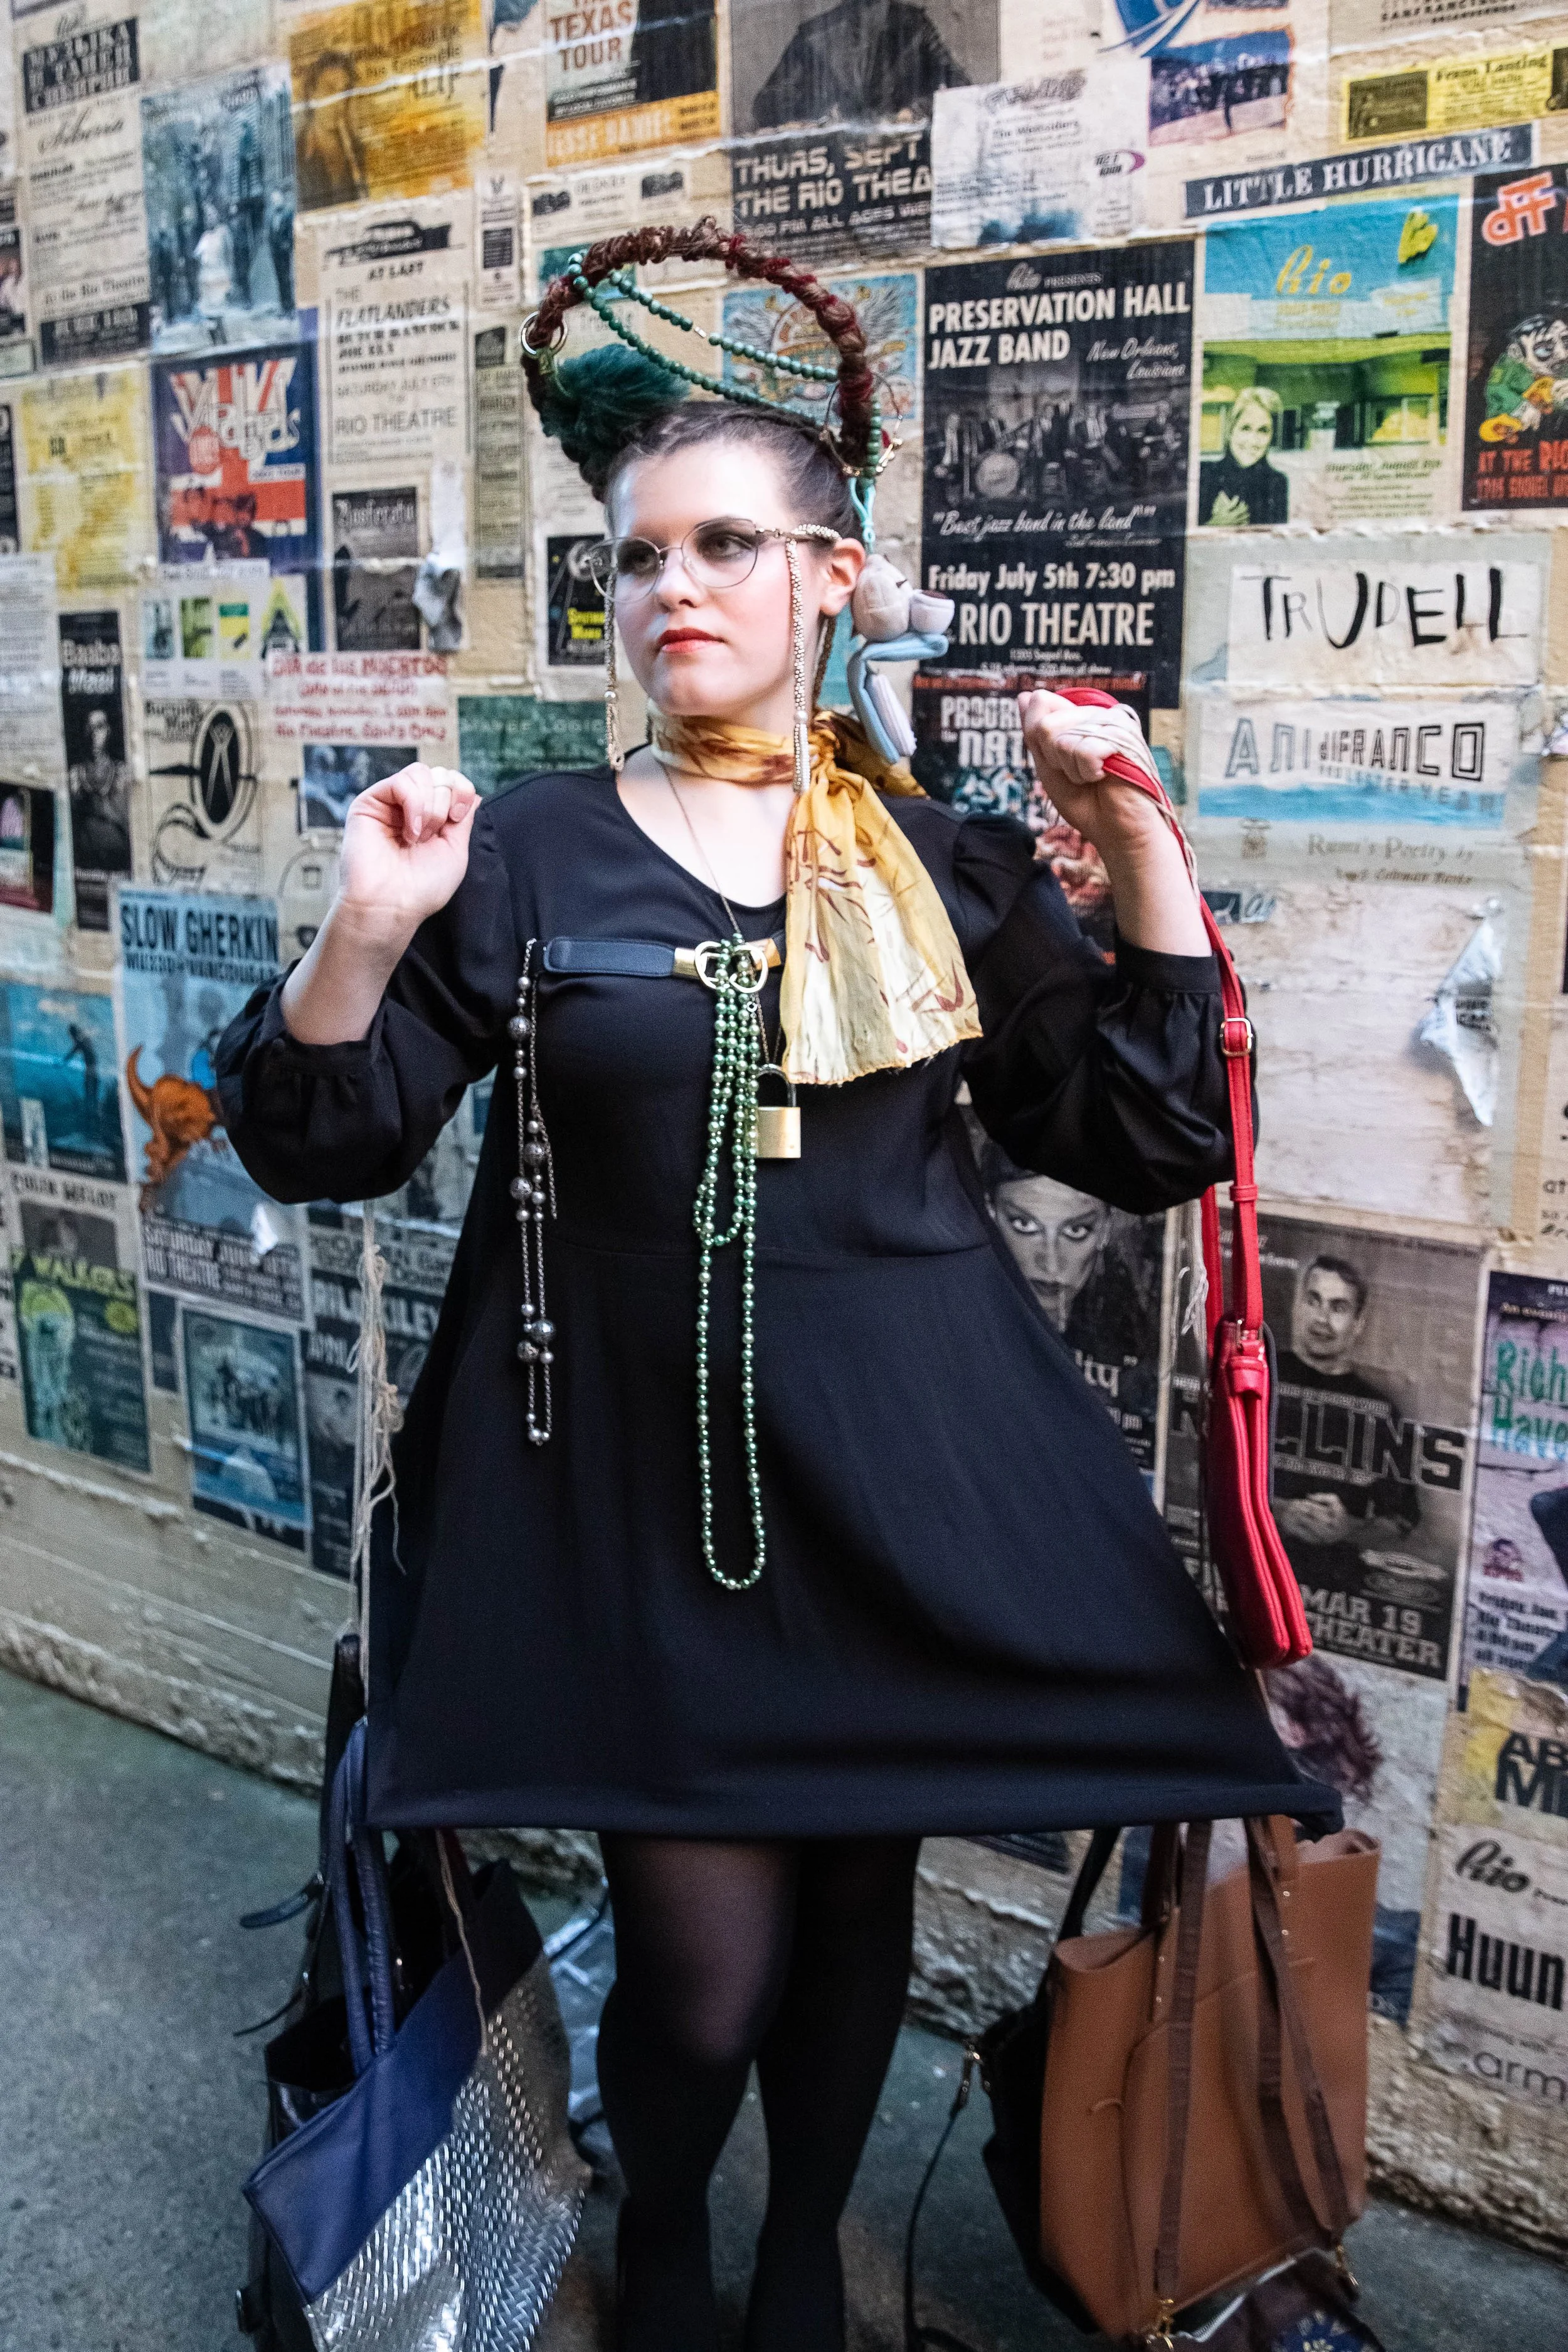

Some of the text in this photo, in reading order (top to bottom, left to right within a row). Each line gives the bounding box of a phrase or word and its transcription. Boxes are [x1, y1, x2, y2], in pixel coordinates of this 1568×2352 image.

[549, 1, 632, 43] TEXAS
[558, 37, 622, 72] TOUR
[734, 132, 922, 185] THURS, SEPT
[1204, 132, 1511, 211] LITTLE HURRICANE
[735, 185, 791, 218] THE
[797, 178, 845, 209] RIO
[337, 294, 451, 327] FLATLANDERS
[929, 282, 1191, 334] PRESERVATION HALL
[927, 330, 1071, 370] JAZZ BAND
[1086, 339, 1118, 361] New
[1126, 361, 1185, 381] Louisiana
[334, 406, 458, 435] RIO THEATRE
[1478, 451, 1496, 473] AT
[1502, 448, 1533, 472] THE
[973, 514, 1012, 543] jazz
[1013, 509, 1054, 531] band
[1053, 512, 1066, 531] in
[1068, 508, 1096, 531] the
[929, 563, 1175, 596] Friday July 5th 7:30 pm
[959, 602, 1155, 647] RIO THEATRE
[1241, 566, 1529, 649] TRUDELL
[121, 903, 279, 963] SLOW GHERKIN
[145, 1225, 213, 1258] SATURDAY
[169, 1253, 221, 1291] THEATRE
[1299, 1584, 1422, 1636] MAR 19
[1447, 1912, 1565, 2012] Huun
[1458, 2043, 1568, 2106] arm
